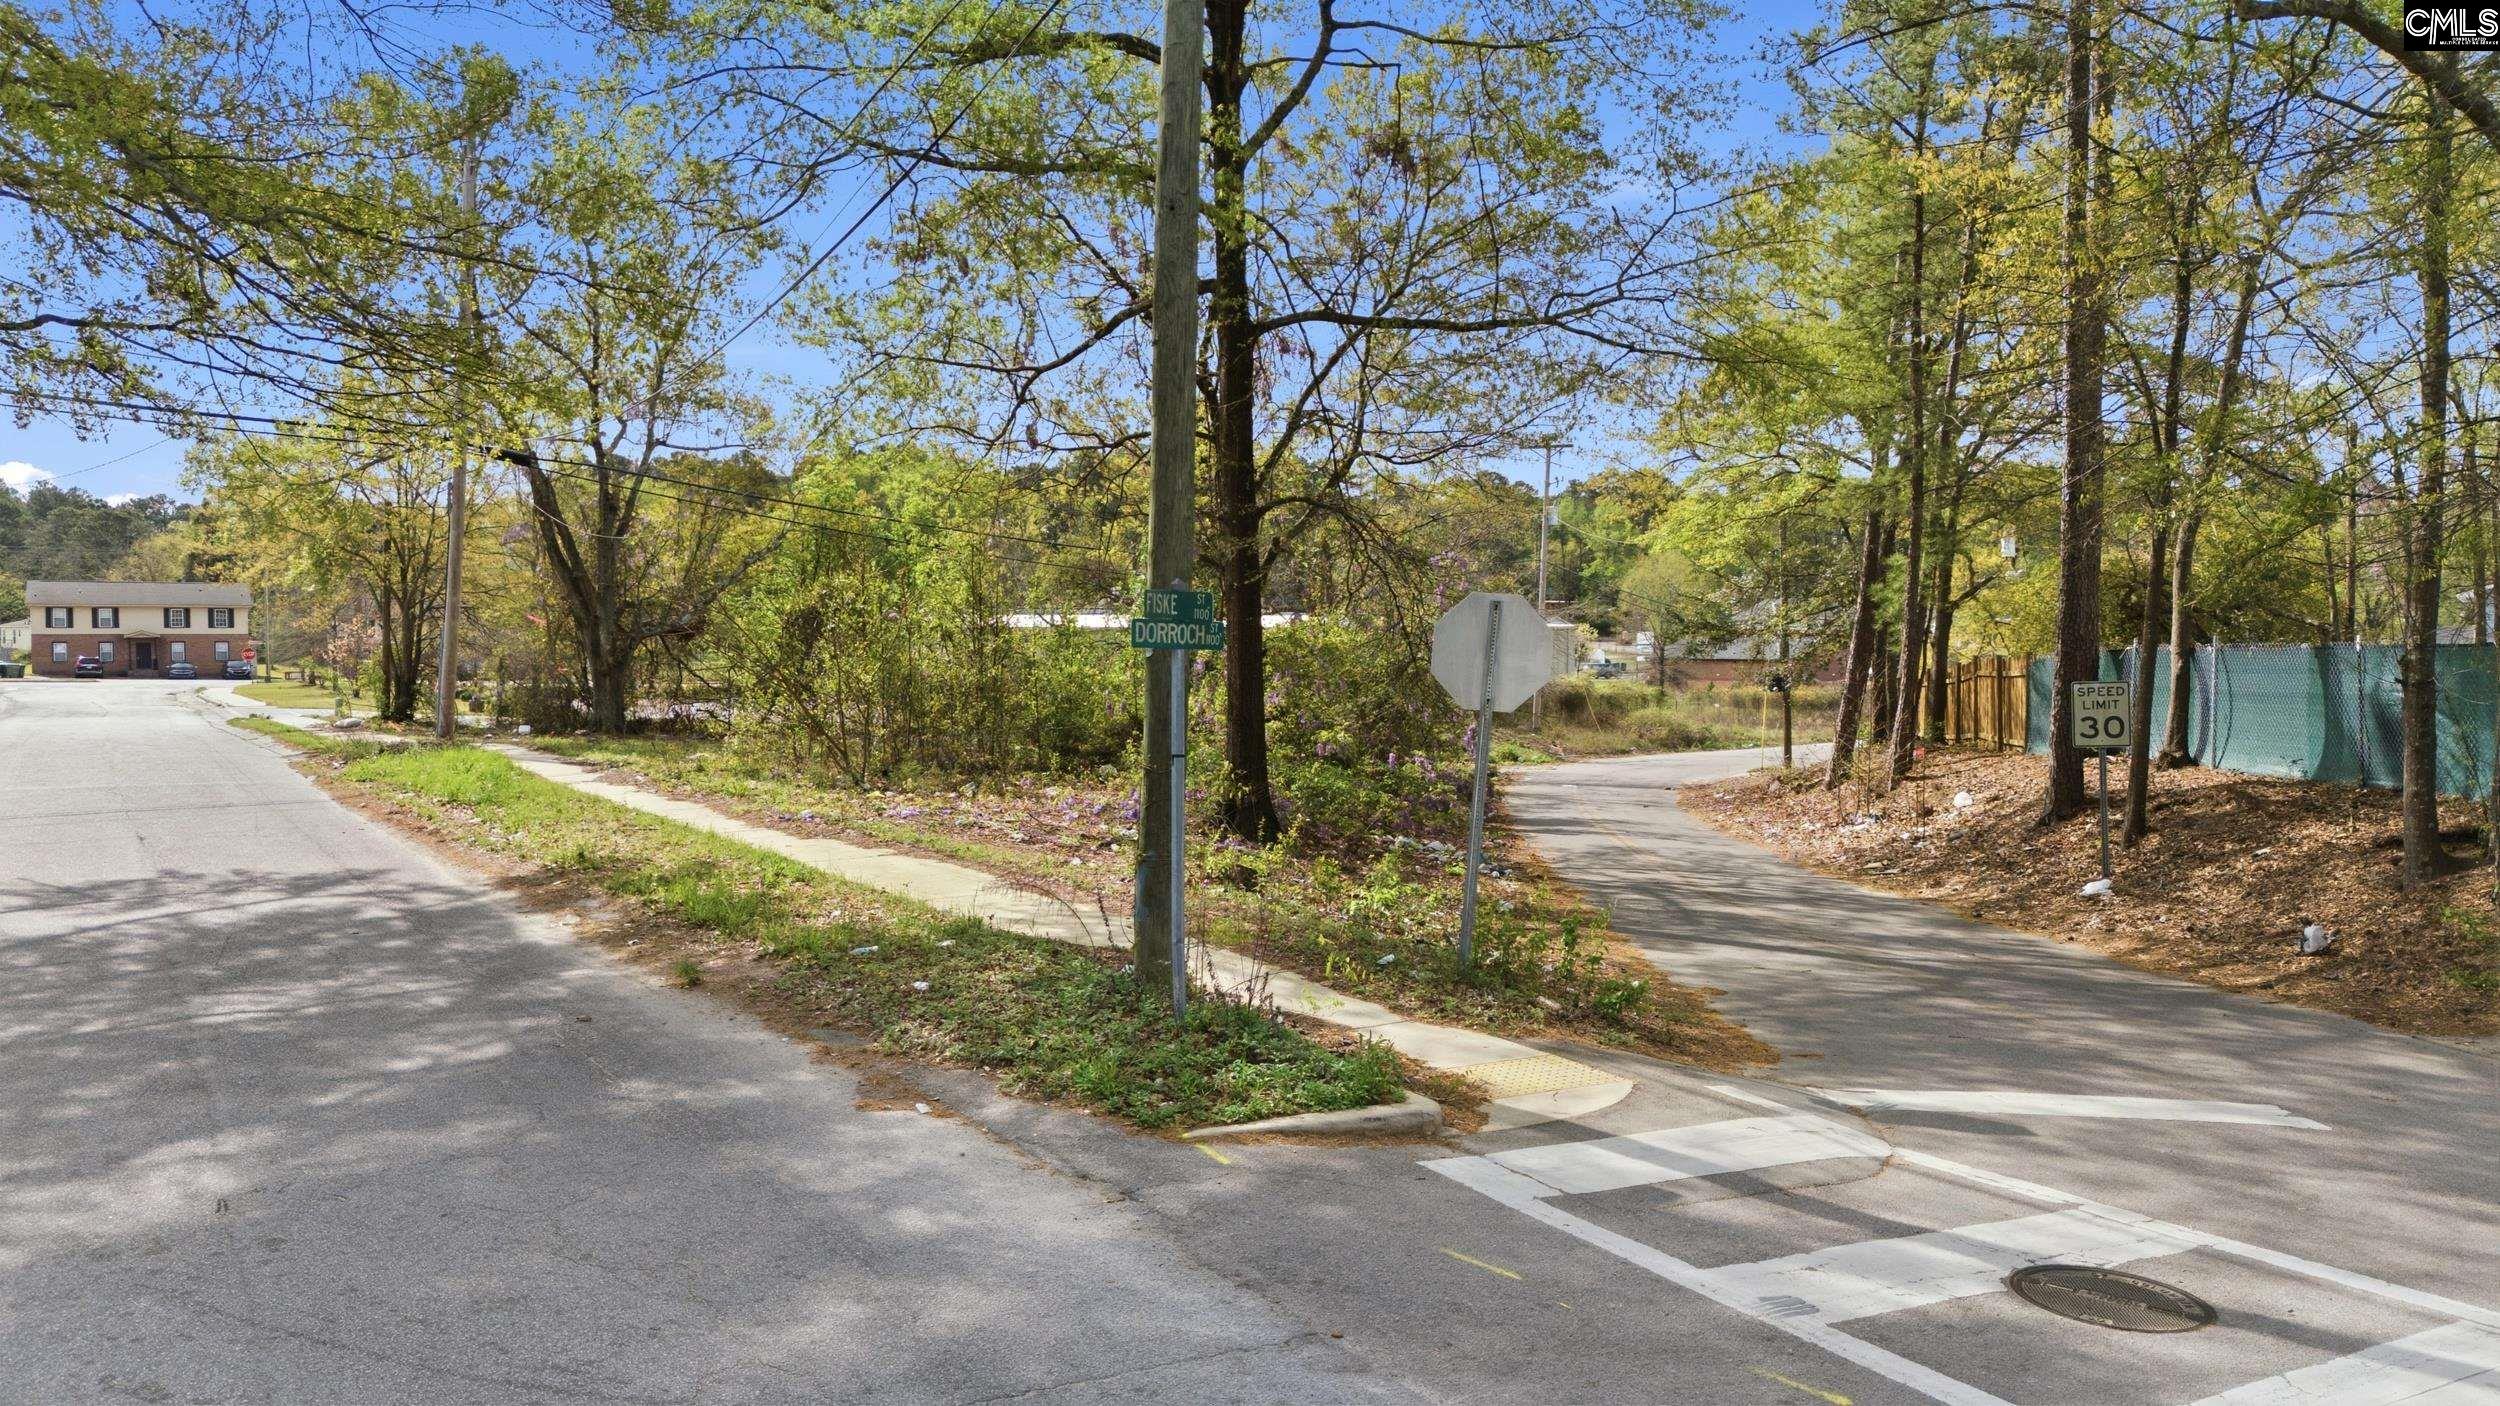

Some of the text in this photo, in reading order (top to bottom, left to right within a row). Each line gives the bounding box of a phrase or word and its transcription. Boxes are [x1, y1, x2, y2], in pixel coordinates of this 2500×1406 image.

[1146, 593, 1178, 615] FISKE
[1135, 622, 1206, 645] DORROCH
[2077, 686, 2125, 697] SPEED
[2083, 699, 2120, 710] LIMIT
[2080, 715, 2125, 739] 30
